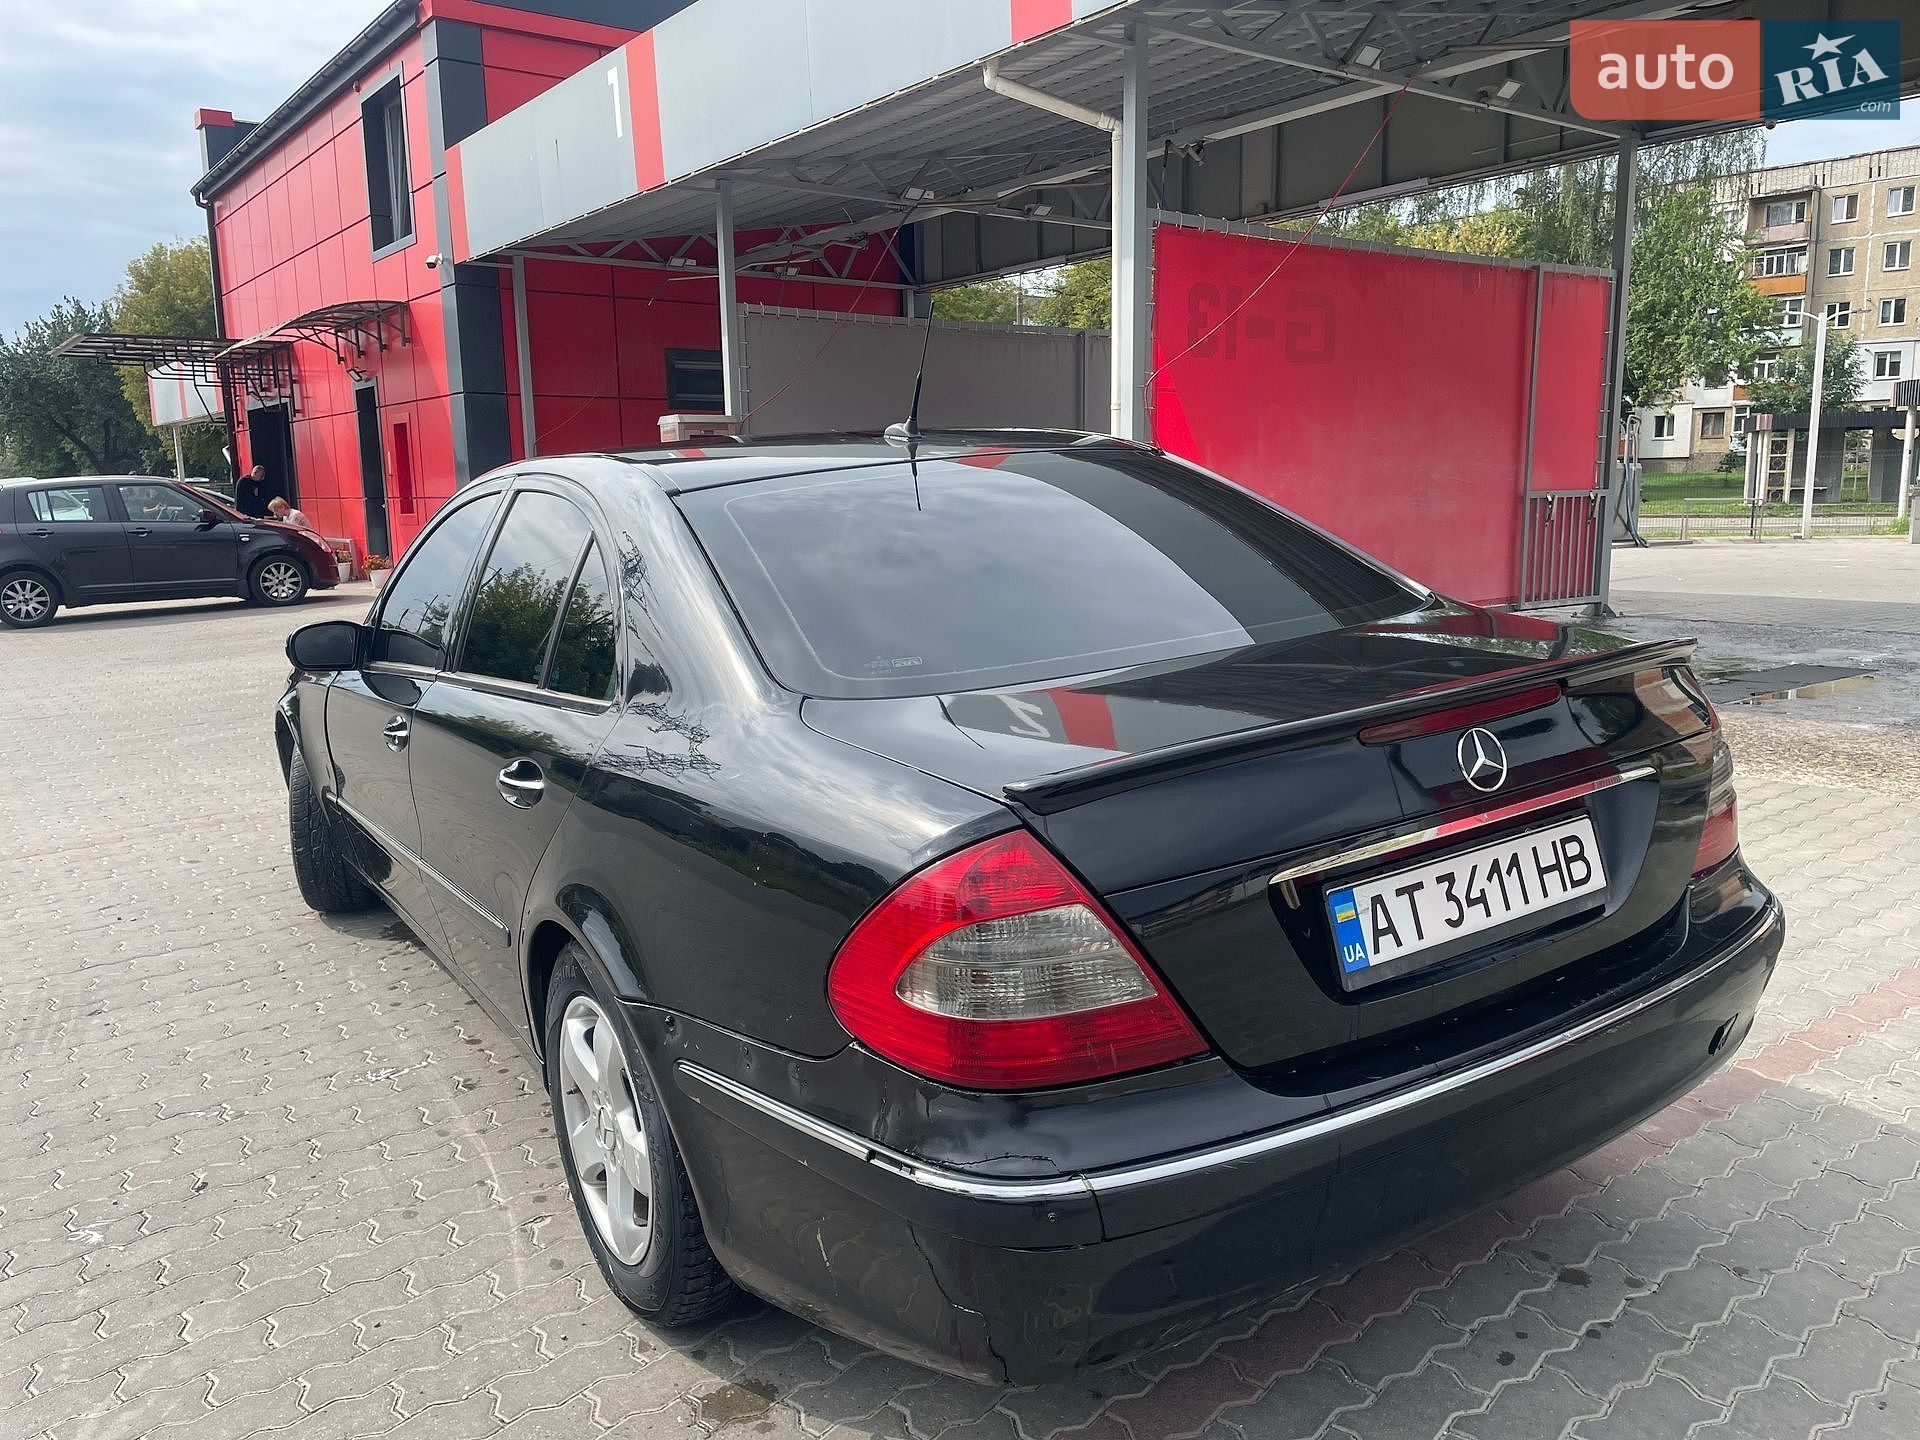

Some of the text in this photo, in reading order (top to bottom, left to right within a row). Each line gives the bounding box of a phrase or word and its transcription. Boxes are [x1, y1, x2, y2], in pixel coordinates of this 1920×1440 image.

[607, 66, 623, 138] 1
[1369, 833, 1593, 956] AT 3411 HB
[1343, 942, 1366, 964] UA
